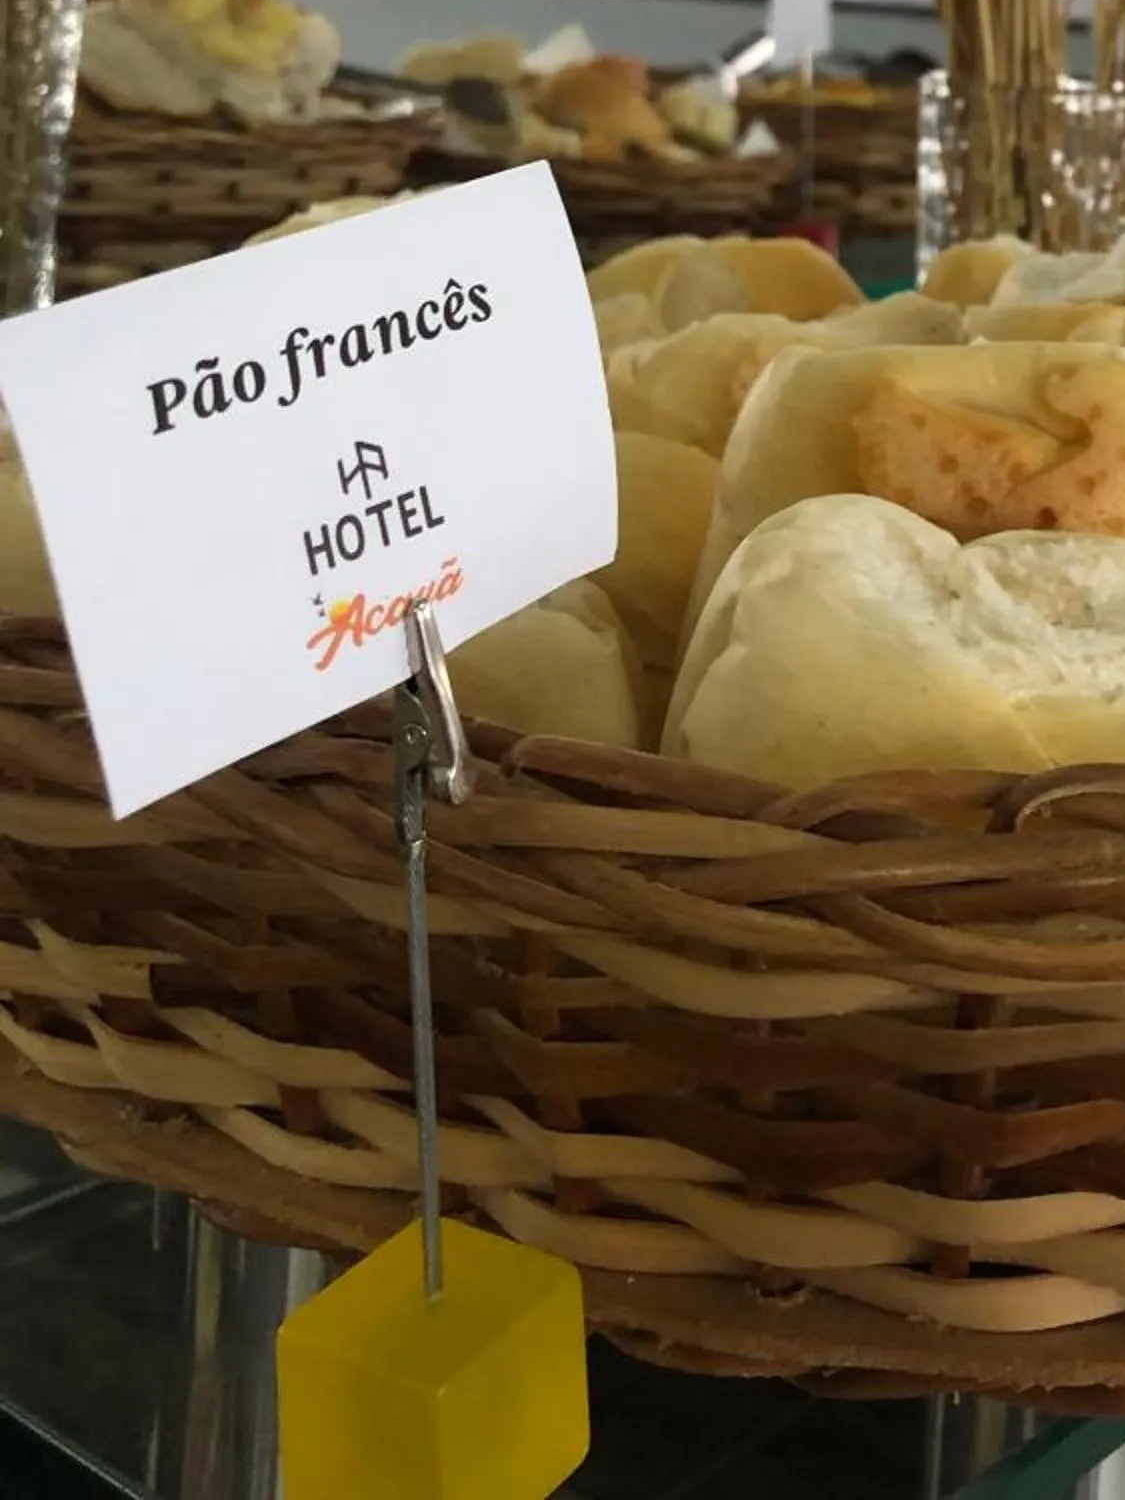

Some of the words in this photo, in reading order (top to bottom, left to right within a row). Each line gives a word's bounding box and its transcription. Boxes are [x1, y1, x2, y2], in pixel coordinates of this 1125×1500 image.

[146, 357, 267, 435] Pão
[278, 278, 494, 406] francês
[304, 485, 445, 575] HOTEL
